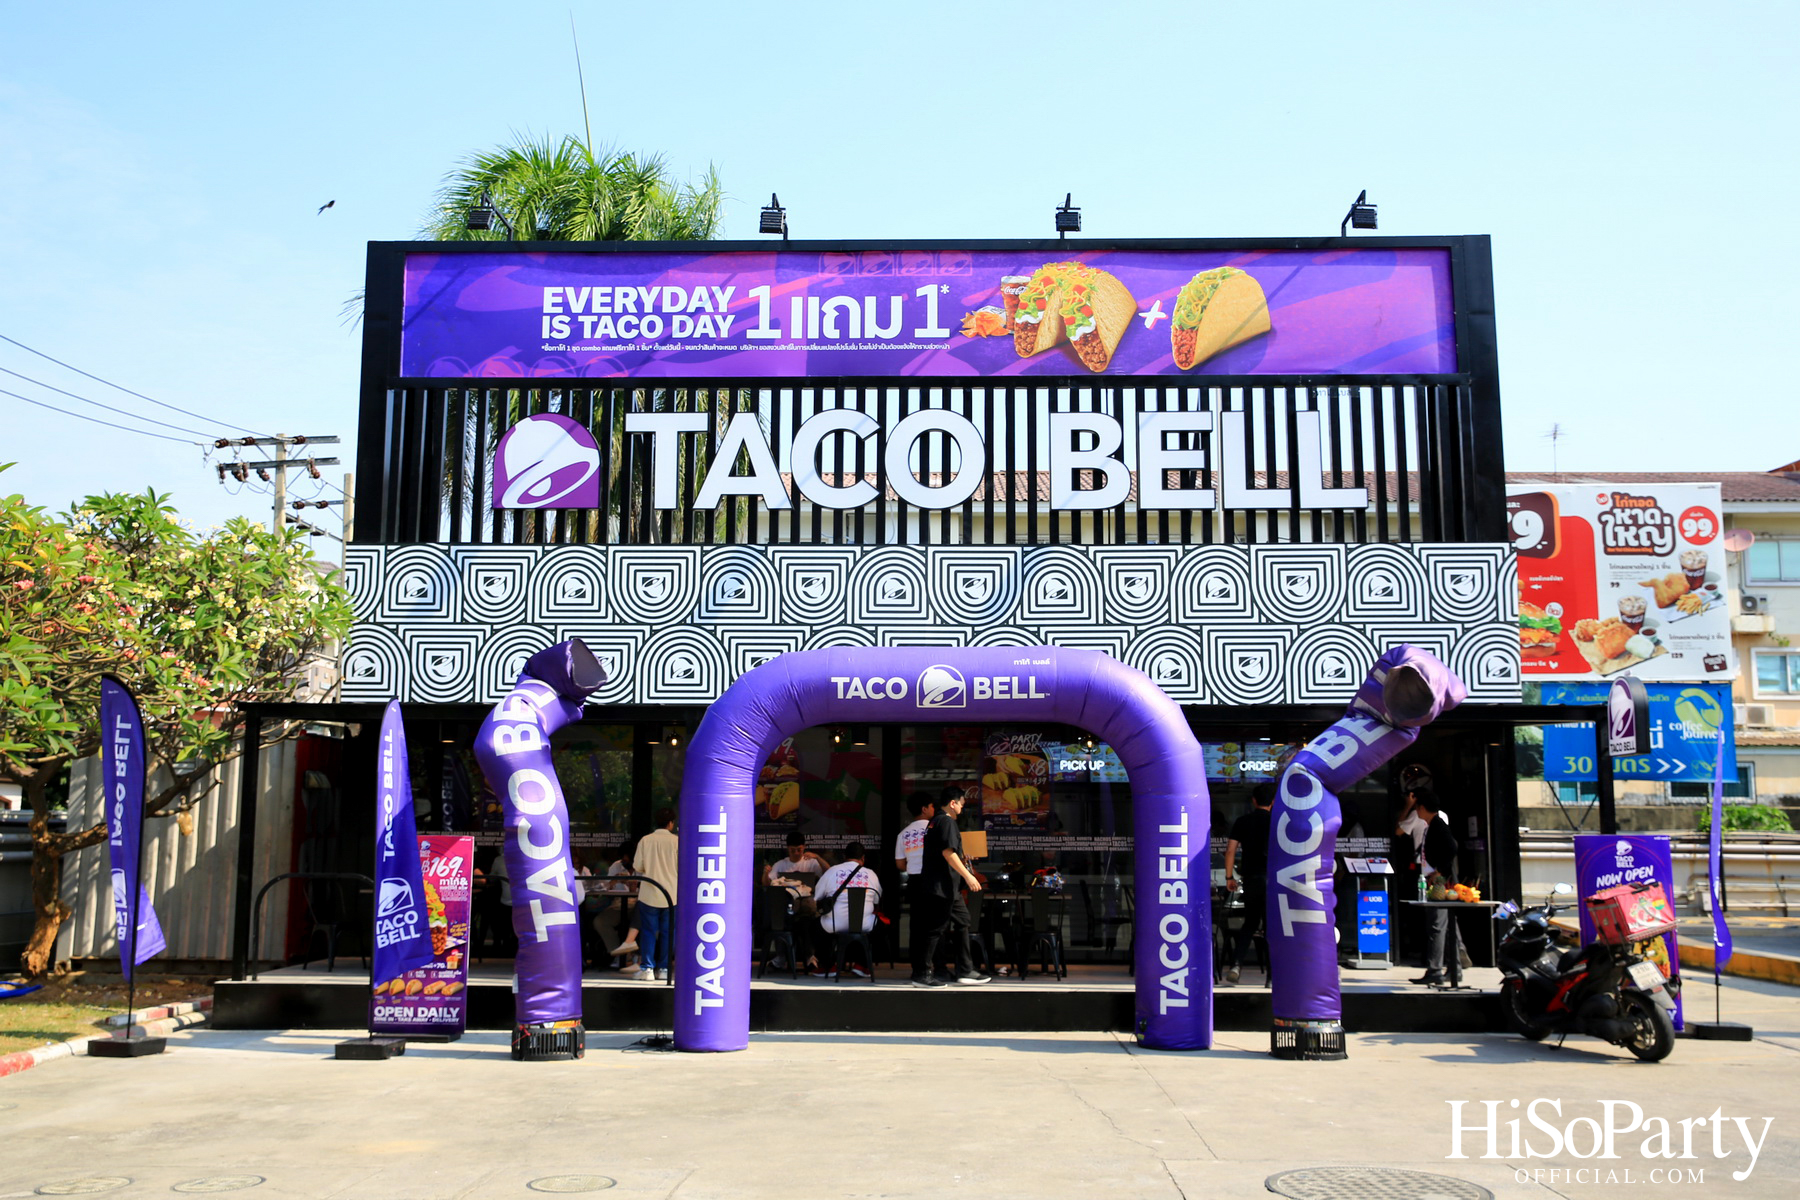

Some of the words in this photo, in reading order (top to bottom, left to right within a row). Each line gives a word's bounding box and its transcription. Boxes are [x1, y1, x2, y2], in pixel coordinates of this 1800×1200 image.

[542, 286, 737, 314] EVERYDAY
[747, 285, 782, 339] 1
[791, 295, 903, 339] แถม
[542, 315, 570, 338] IS
[583, 315, 663, 339] TACO
[671, 315, 736, 338] DAY
[625, 408, 986, 510] TACO
[1049, 409, 1369, 510] BELL
[1612, 507, 1662, 525] หาด
[1600, 513, 1673, 555] ใหญ่
[830, 676, 908, 700] TACO
[973, 676, 1045, 700] BELL
[1010, 733, 1043, 744] PARTY
[1011, 743, 1038, 753] PACK
[1610, 742, 1622, 753] TACO
[1623, 740, 1636, 751] BELL
[383, 728, 393, 789] BELL
[1060, 760, 1086, 771] PICK
[1088, 760, 1105, 771] UP
[1239, 760, 1278, 772] ORDER
[1562, 757, 1593, 774] 30
[383, 797, 394, 862] TACO
[516, 768, 577, 943] TACO
[696, 812, 728, 904] BELL
[1158, 812, 1189, 905] BELL
[1277, 761, 1328, 937] TACO
[1614, 855, 1635, 863] TACO
[1596, 871, 1623, 888] NOW
[1624, 865, 1654, 882] OPEN
[376, 924, 421, 949] BELL
[695, 911, 727, 1016] TACO
[1158, 914, 1190, 1016] TACO
[373, 1006, 414, 1018] OPEN
[417, 1007, 460, 1018] DAILY
